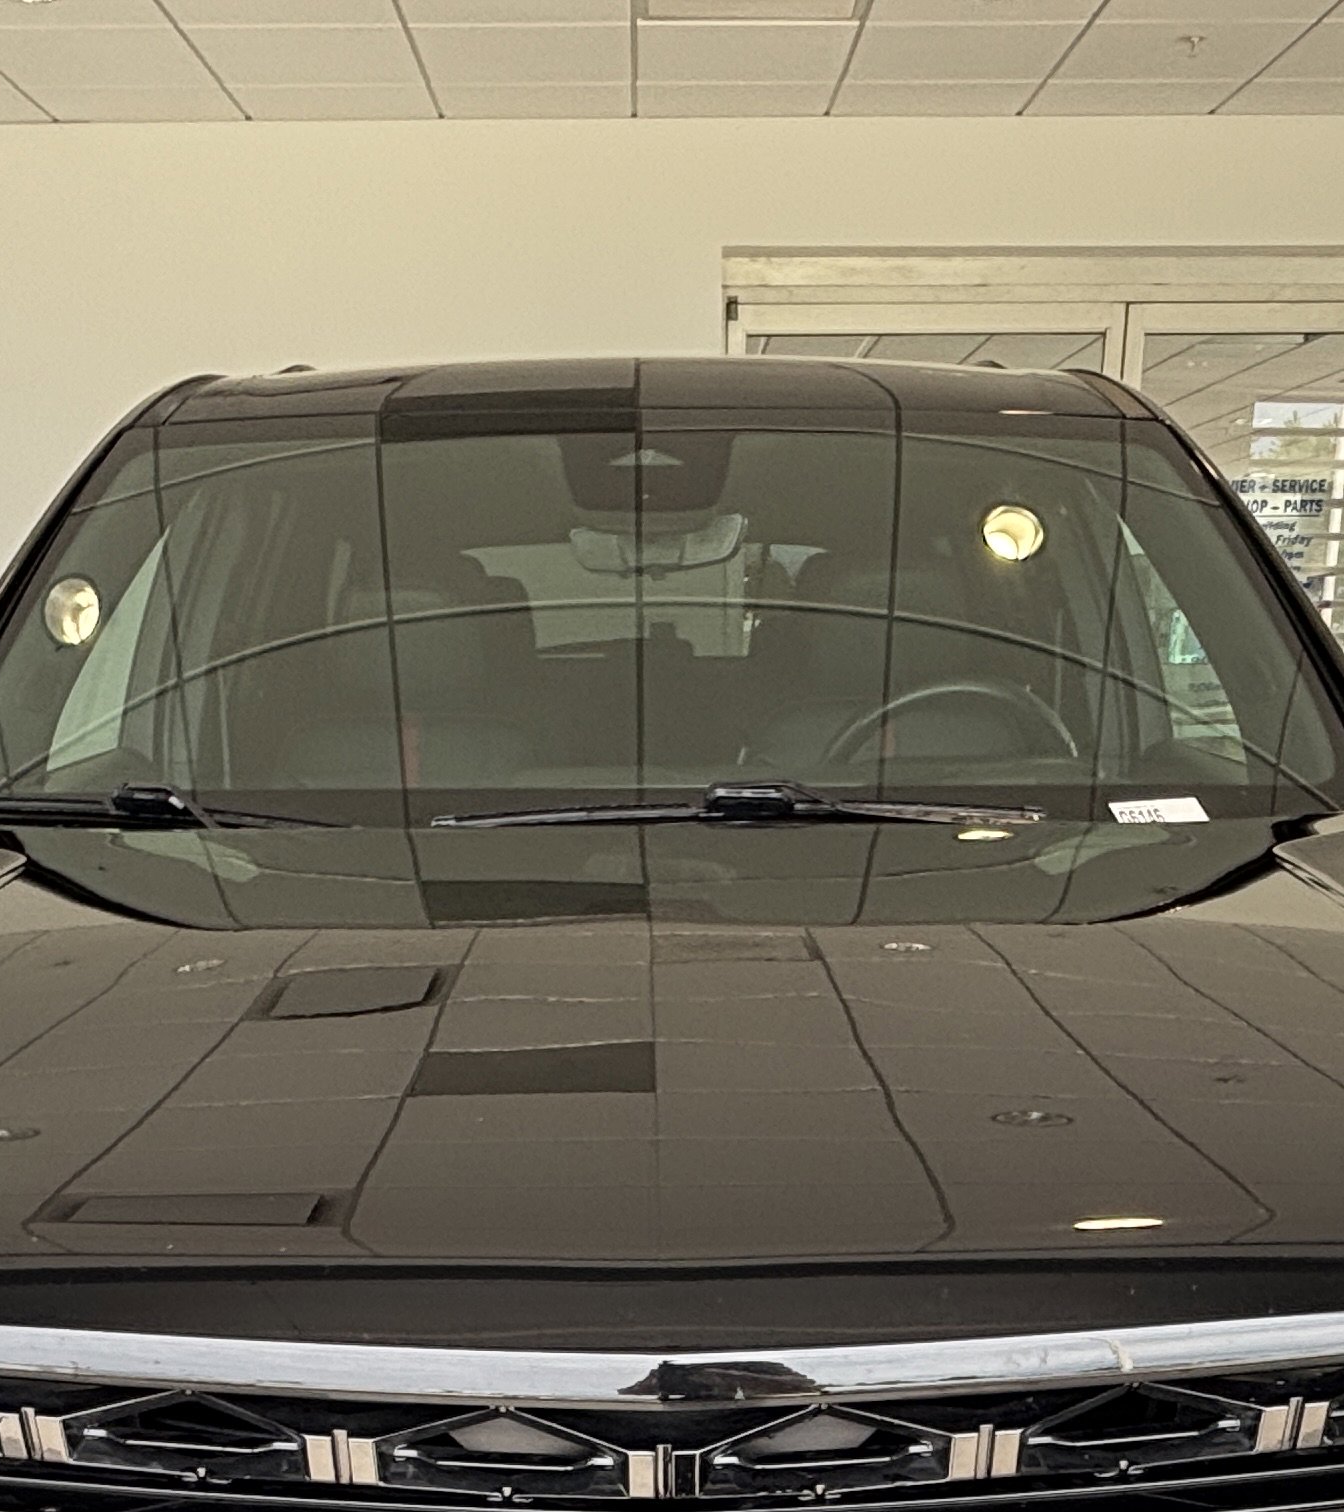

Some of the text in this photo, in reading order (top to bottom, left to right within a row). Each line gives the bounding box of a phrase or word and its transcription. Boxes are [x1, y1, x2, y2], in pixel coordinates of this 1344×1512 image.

[1272, 479, 1327, 493] SERVICE
[1283, 499, 1324, 513] PARTS
[1275, 534, 1314, 547] Friday
